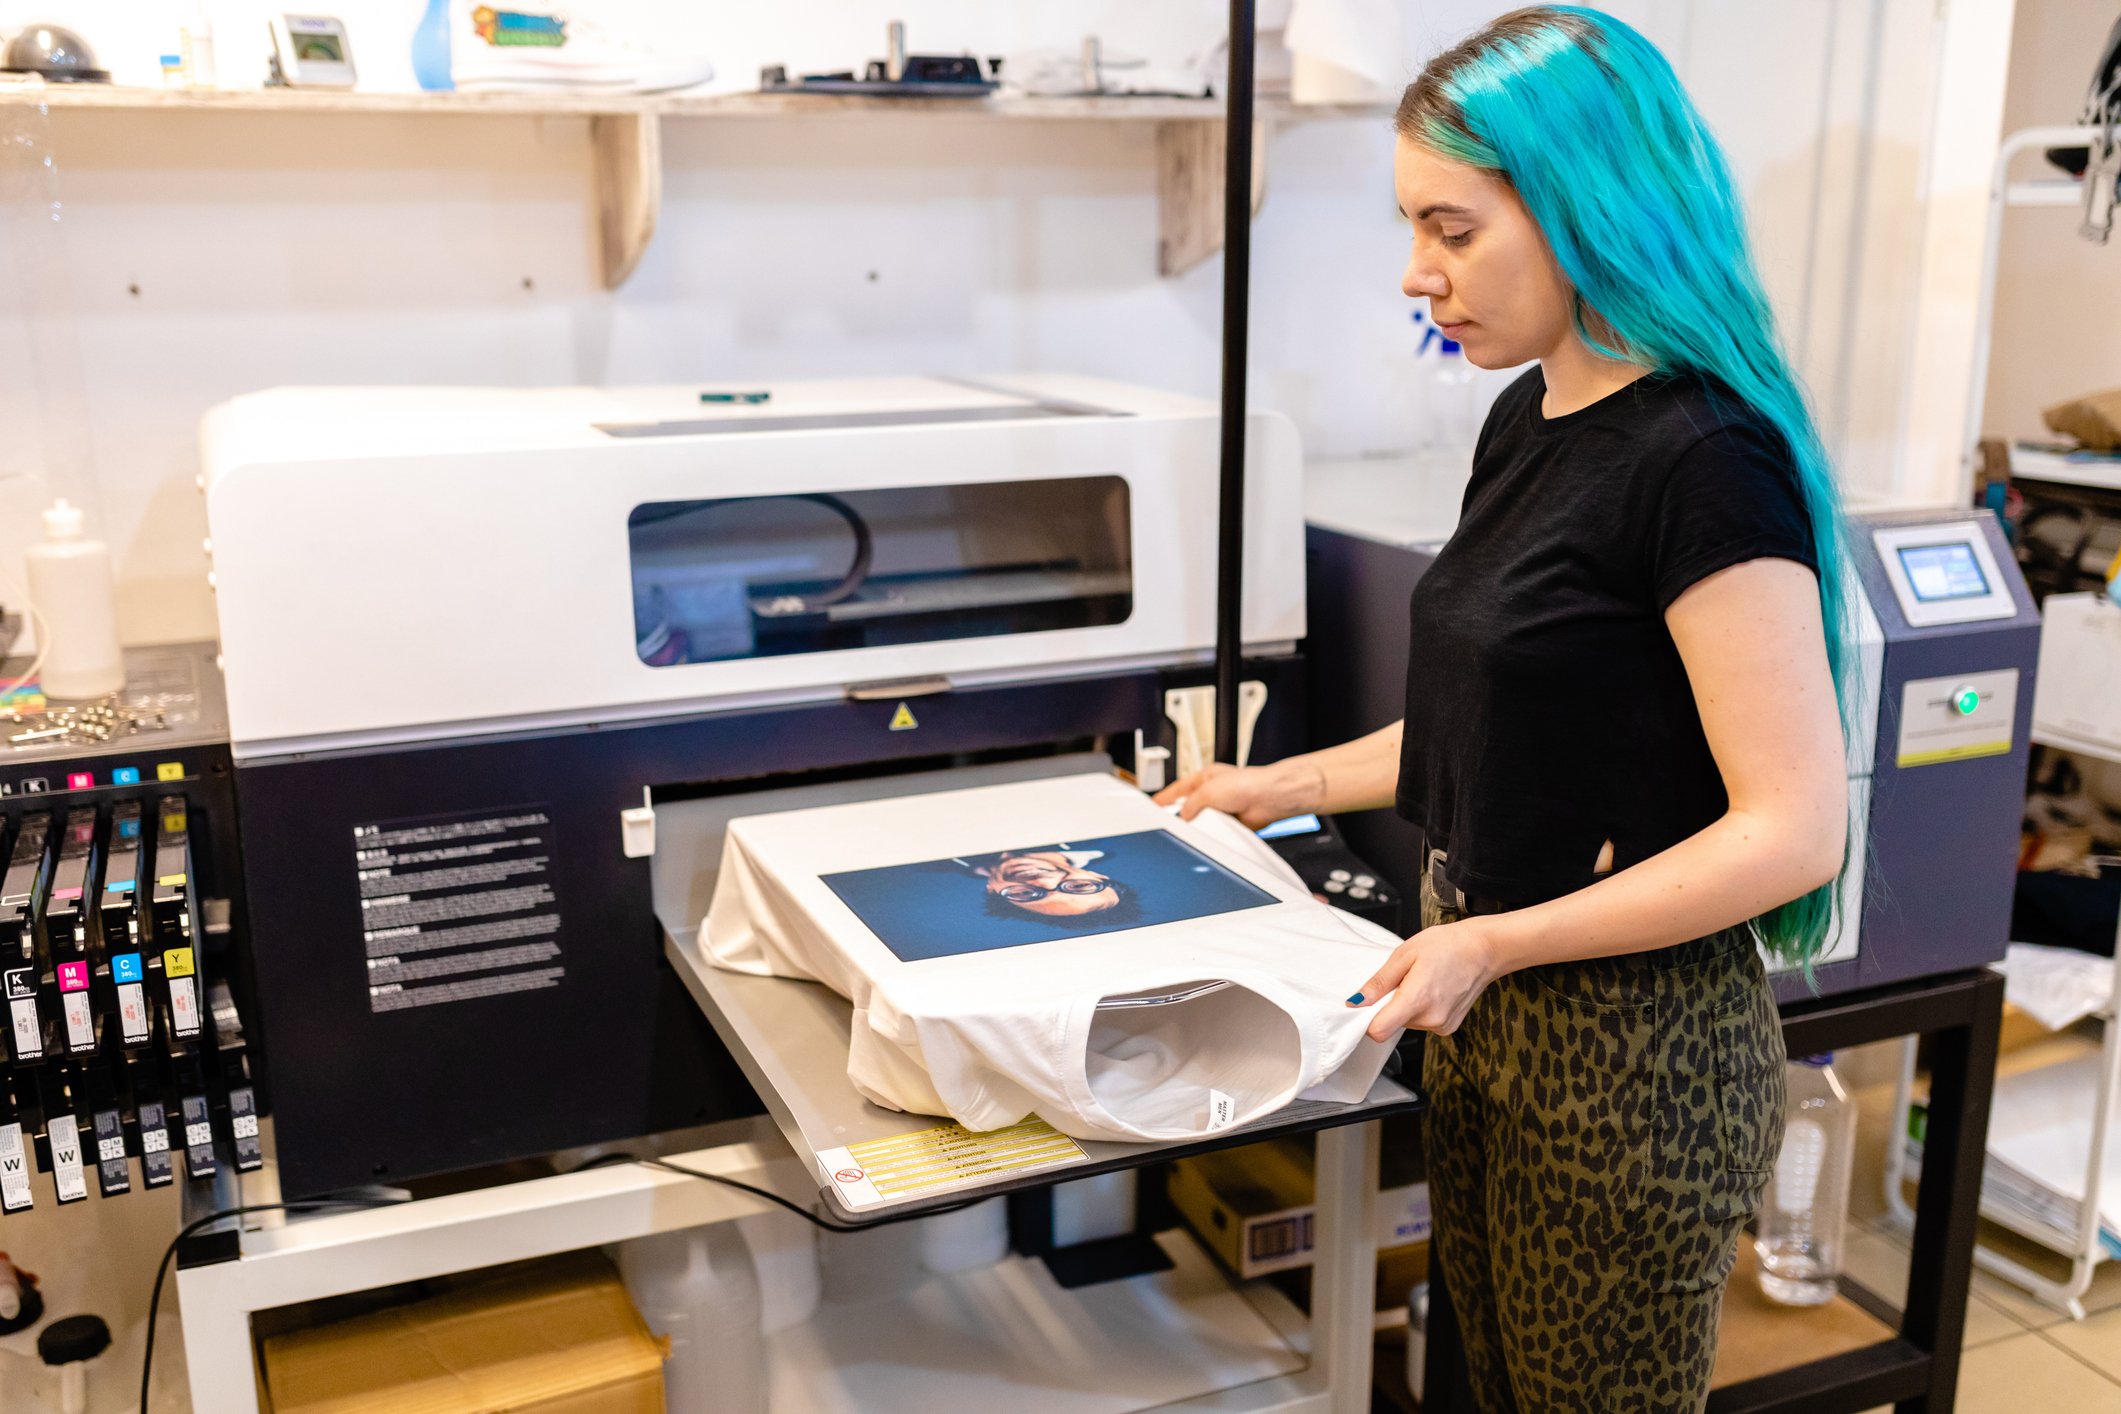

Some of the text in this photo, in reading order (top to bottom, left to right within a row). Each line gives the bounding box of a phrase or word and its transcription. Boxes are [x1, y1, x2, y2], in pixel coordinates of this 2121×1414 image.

[29, 780, 41, 793] K
[73, 775, 88, 788] M
[121, 770, 131, 782] C
[172, 954, 180, 963] Y
[120, 960, 130, 969] C
[64, 967, 77, 978] M
[12, 973, 23, 985] K
[176, 1029, 200, 1037] brother
[124, 1035, 149, 1044] brother
[70, 1044, 96, 1053] brother
[18, 1051, 43, 1060] brother
[58, 1150, 75, 1163] W
[4, 1158, 20, 1171] W
